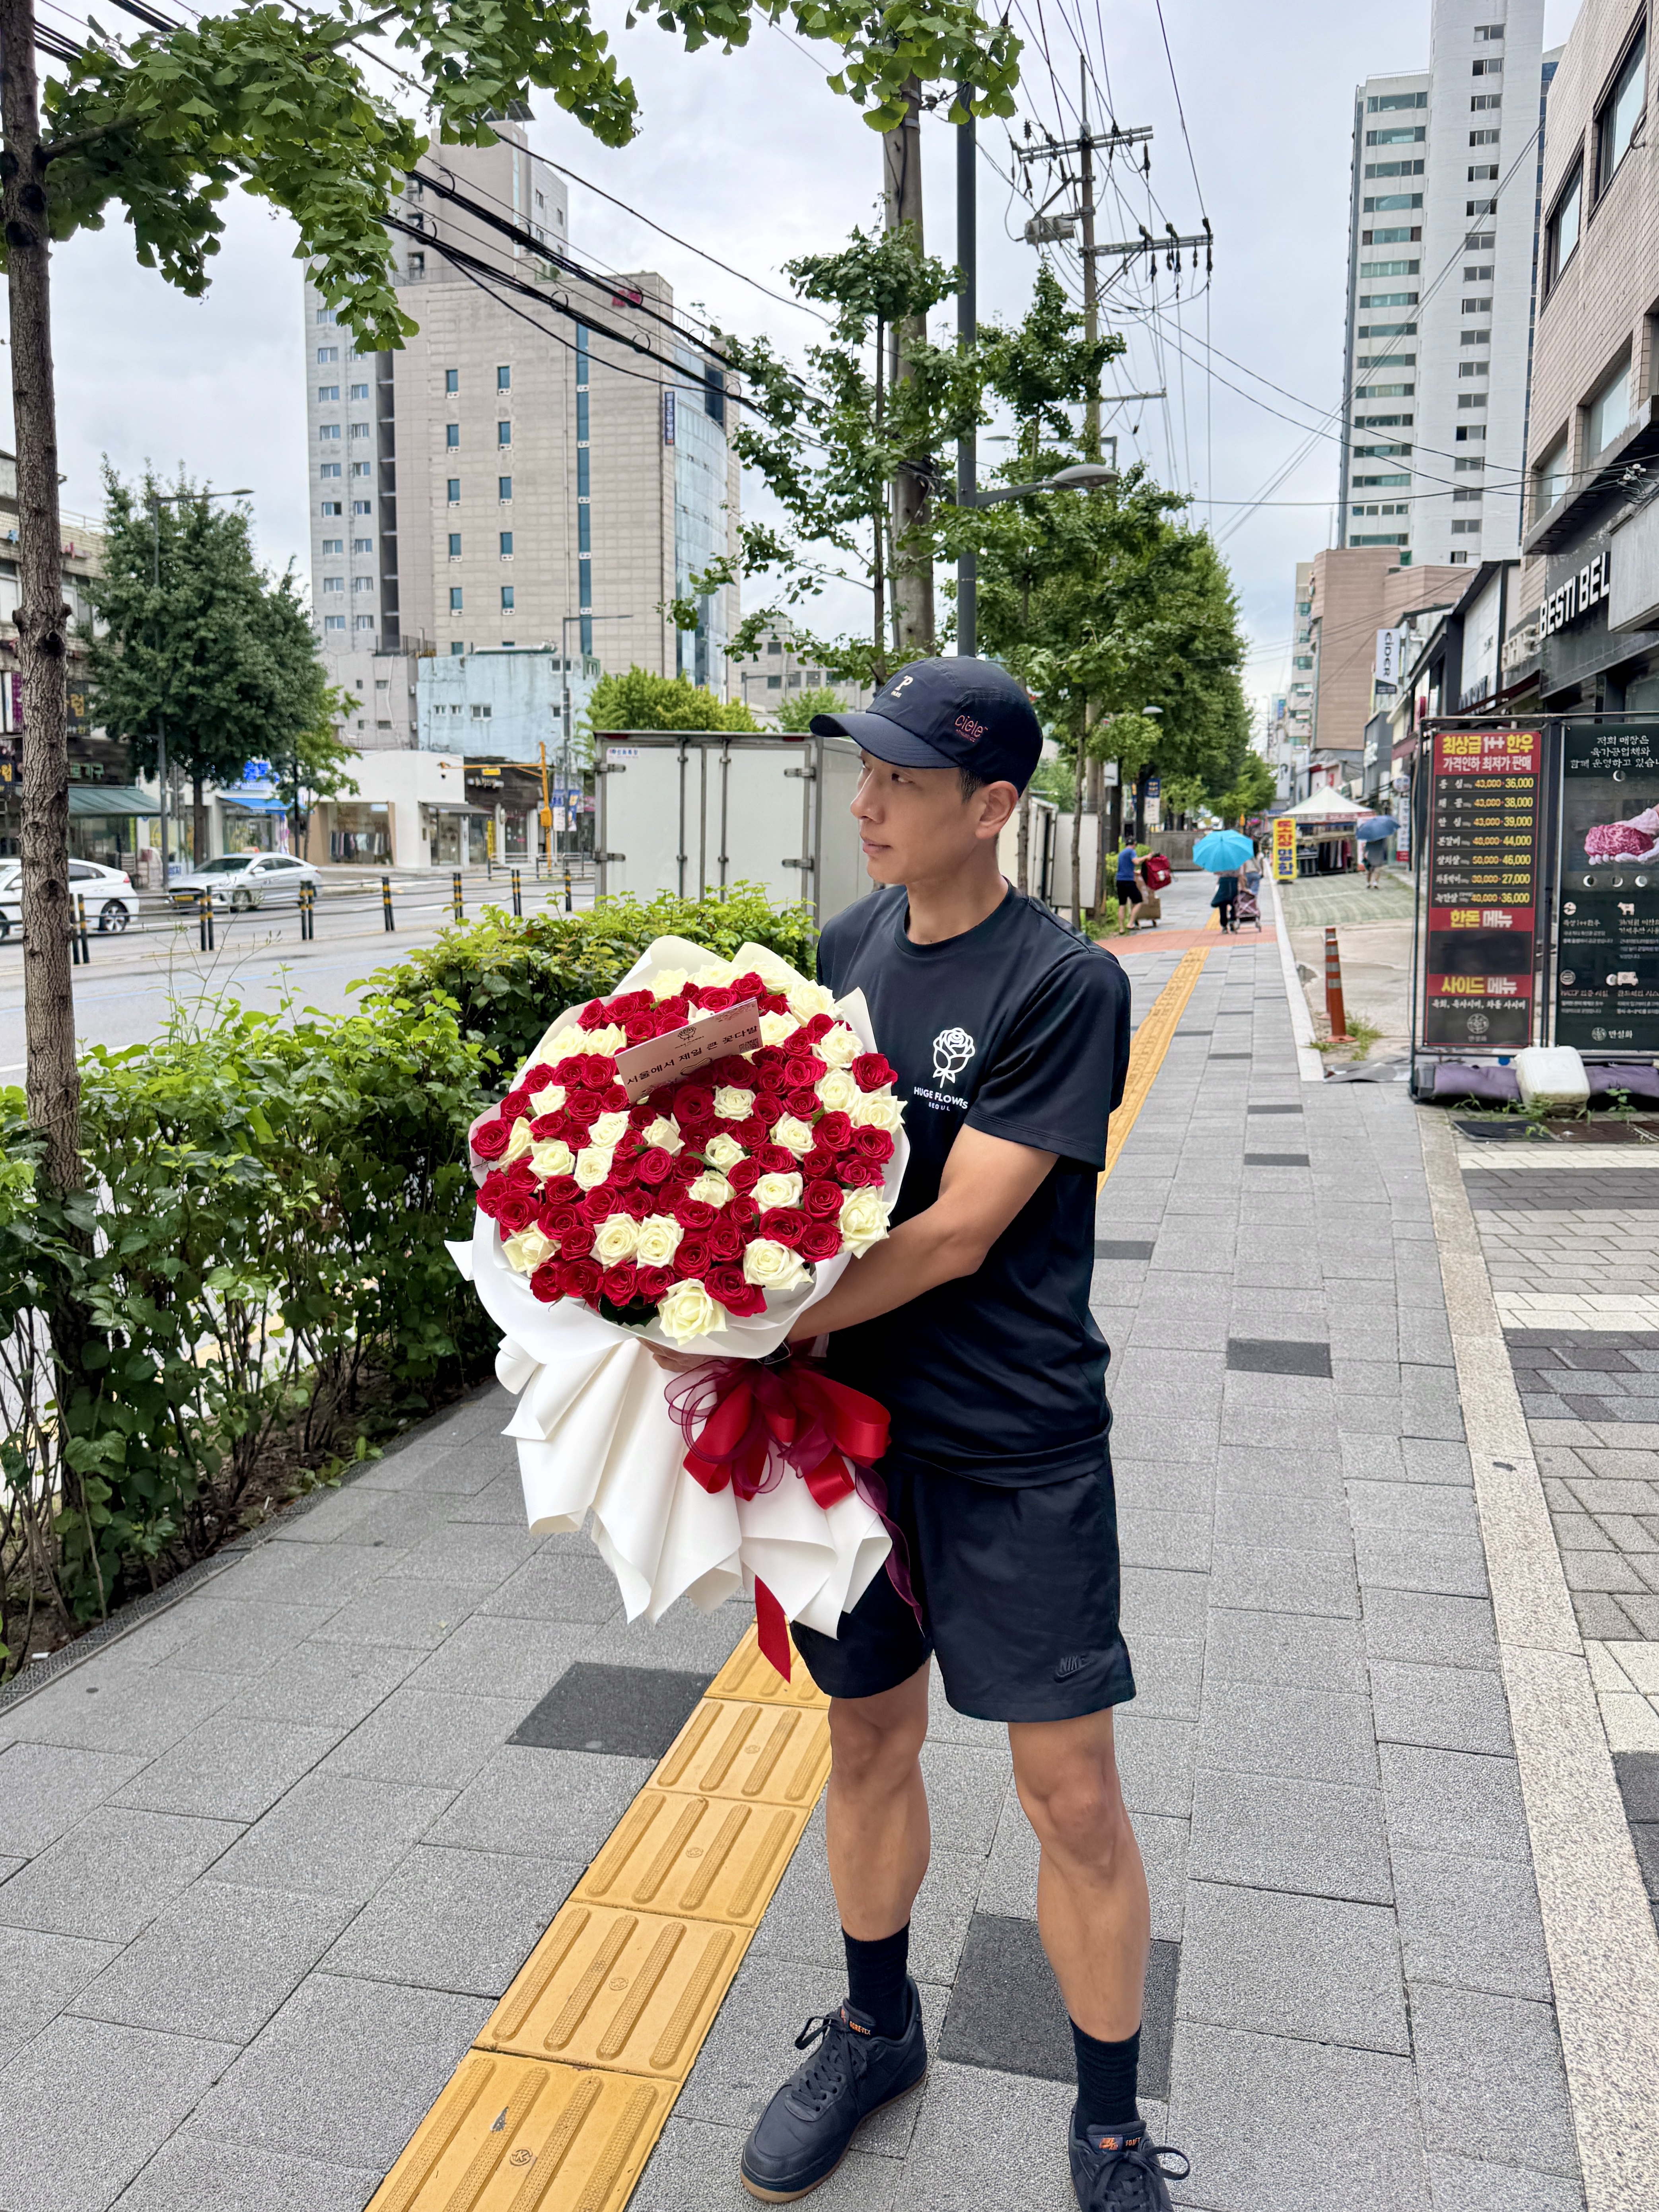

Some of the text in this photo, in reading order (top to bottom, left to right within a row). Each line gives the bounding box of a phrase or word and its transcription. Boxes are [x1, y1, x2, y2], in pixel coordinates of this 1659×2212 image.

[1539, 576, 1575, 640] BESTI
[1443, 734, 1534, 754] 최상급 1++ 한우
[1597, 735, 1649, 745] 저희 매장은
[1443, 755, 1532, 772] 가격인하 최저가 판매
[1570, 759, 1589, 769] 함께
[1592, 758, 1632, 768] 운영하고
[1505, 778, 1534, 789] 36,000
[1504, 797, 1533, 809] 38,000
[1504, 816, 1532, 828] 39,000
[1503, 836, 1531, 847] 44,000
[1502, 855, 1531, 866] 46,000
[1501, 874, 1530, 885] 27,000
[1501, 892, 1530, 904] 36,000
[1451, 910, 1513, 928] 한돈 메뉴
[1441, 976, 1517, 994] 사이드 메뉴
[627, 1059, 675, 1085] 서울에서
[679, 1048, 702, 1061] 제일
[914, 1087, 933, 1098] HUGE
[1059, 1654, 1088, 1672] NIKE
